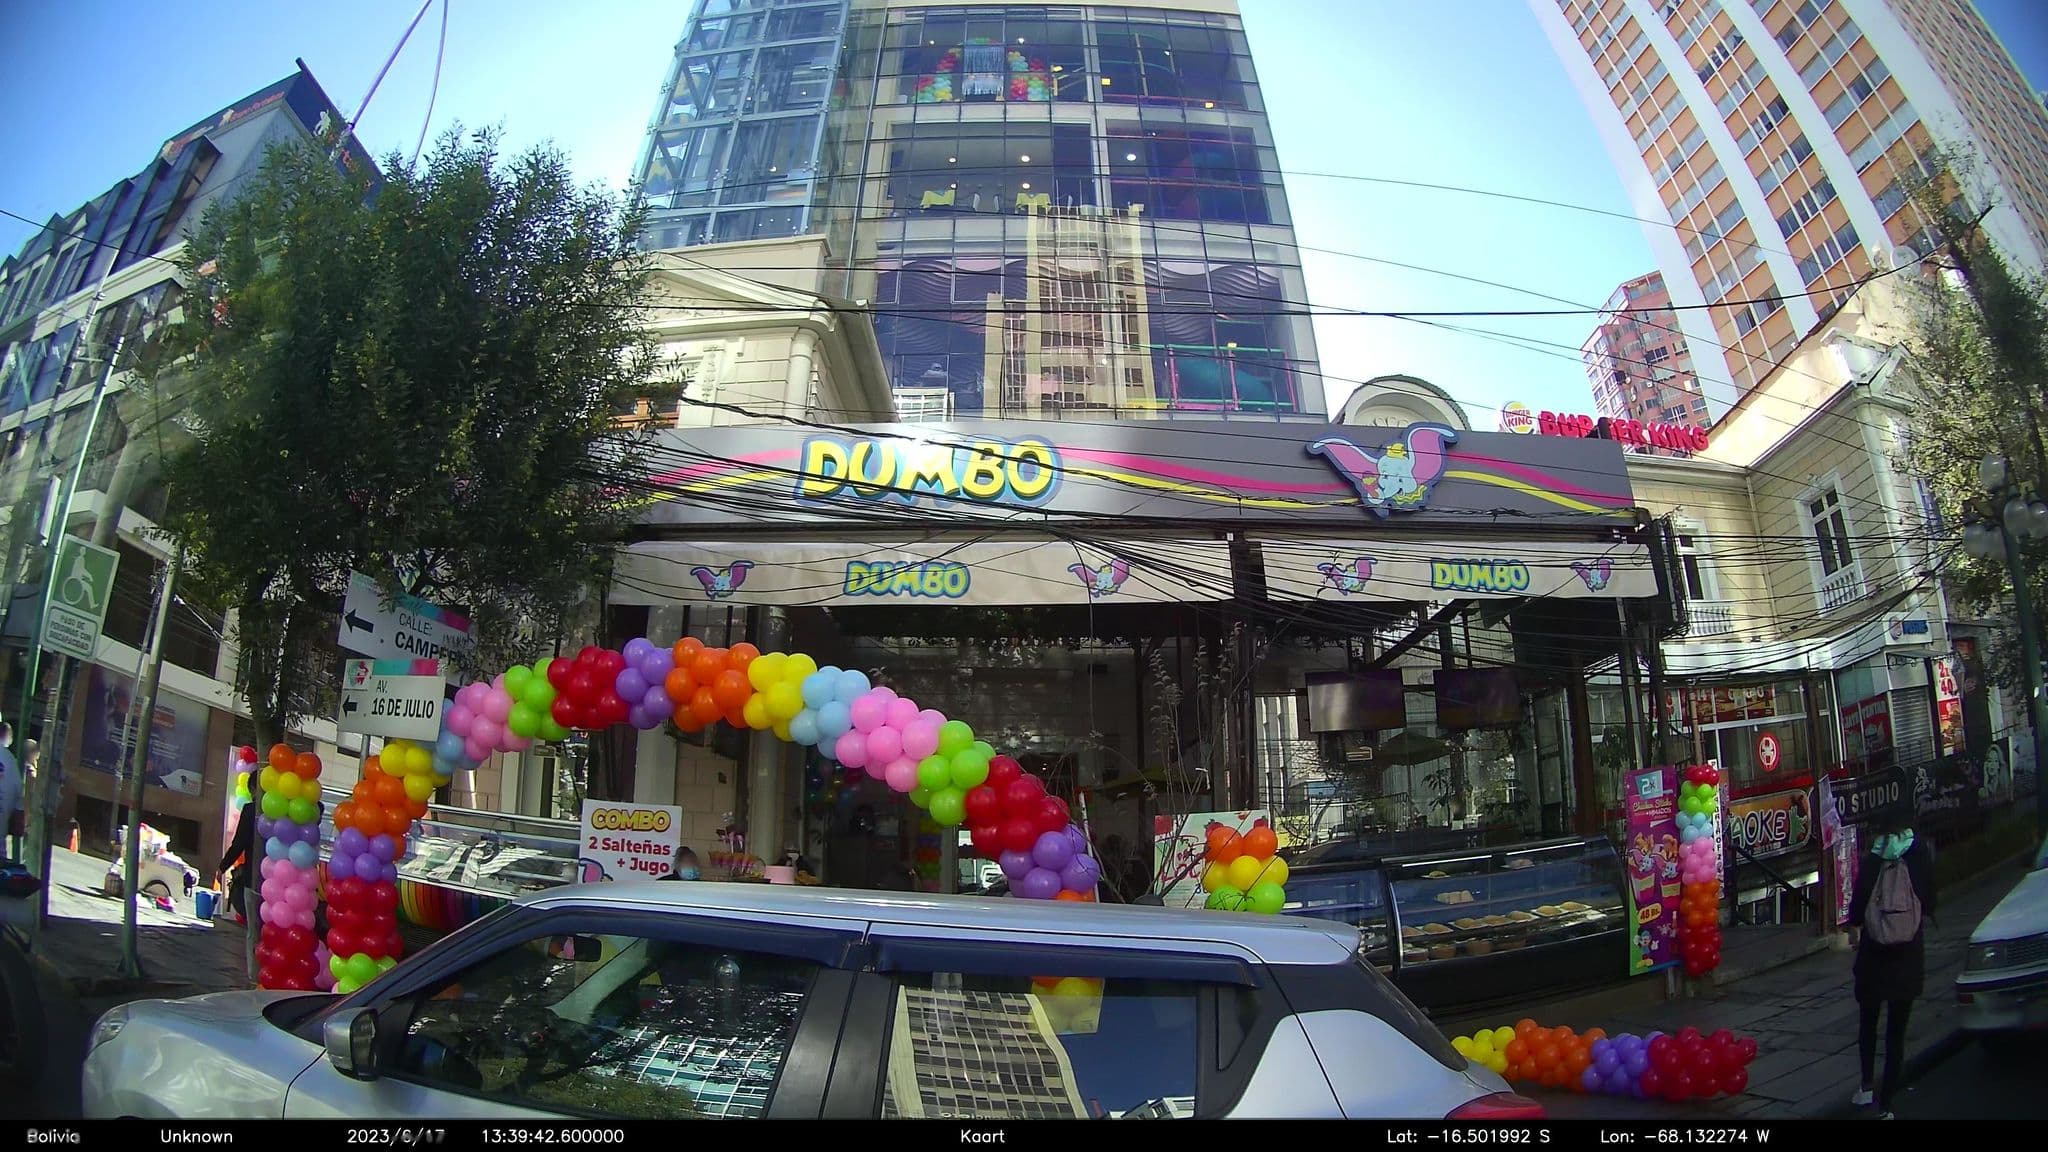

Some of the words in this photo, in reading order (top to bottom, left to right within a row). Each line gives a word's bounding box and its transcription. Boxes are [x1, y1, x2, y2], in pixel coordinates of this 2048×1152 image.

[1508, 416, 1532, 427] KING
[1539, 411, 1644, 447] BURER
[1650, 421, 1709, 451] KING
[799, 438, 1056, 503] DUMBO
[845, 562, 969, 597] DUMBO
[1432, 560, 1529, 591] DUMBO
[399, 612, 433, 636] CALLE:
[376, 680, 388, 694] AV.
[371, 697, 385, 715] 16
[387, 698, 402, 717] DE
[402, 699, 434, 719] JULIO
[1851, 781, 1899, 813] STUDIO
[592, 808, 671, 832] COMBO
[1731, 809, 1786, 849] AOKE
[589, 836, 598, 850] 2
[602, 838, 671, 856] Salteñas
[617, 860, 625, 868] +
[629, 857, 670, 876] Jugo
